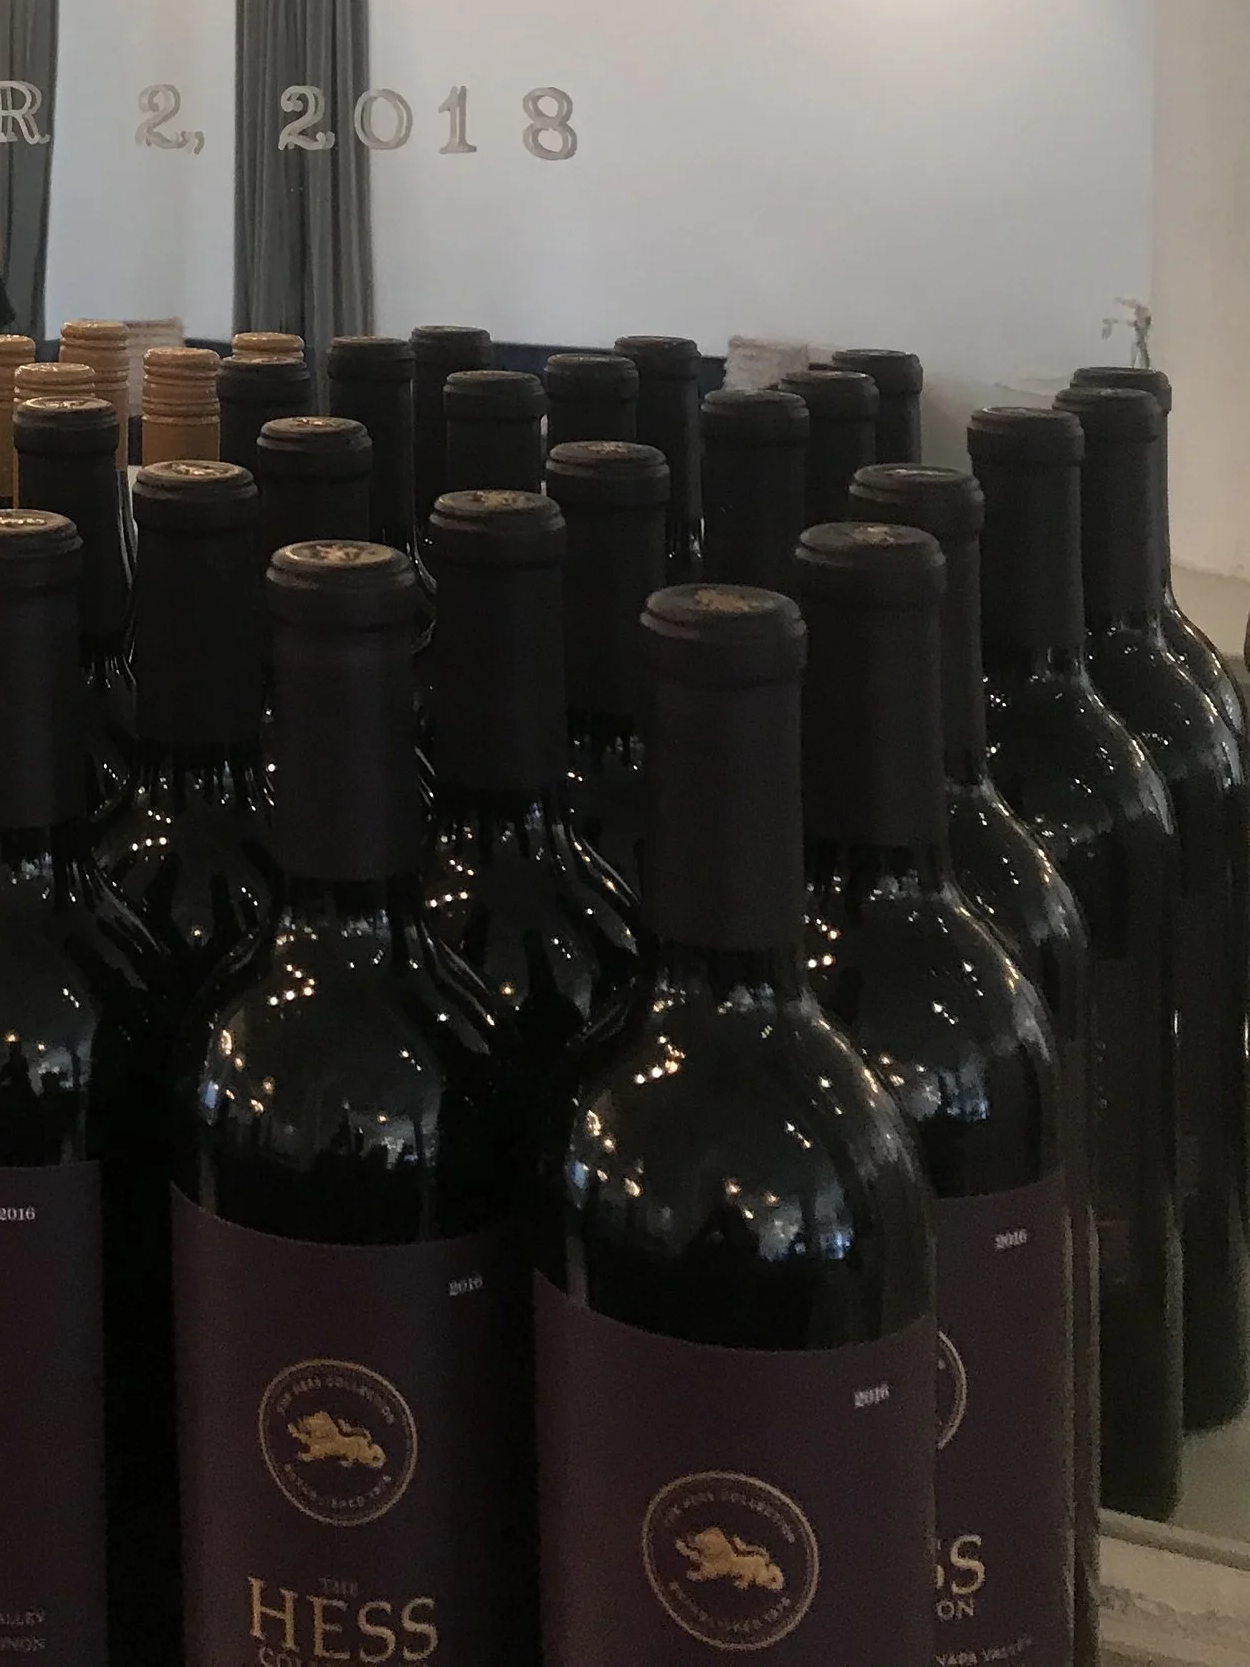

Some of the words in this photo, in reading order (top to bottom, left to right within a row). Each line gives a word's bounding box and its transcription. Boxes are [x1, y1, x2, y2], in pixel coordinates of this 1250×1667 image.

[135, 84, 205, 155] 2,
[278, 84, 578, 160] 2018
[247, 1575, 440, 1664] HESS
